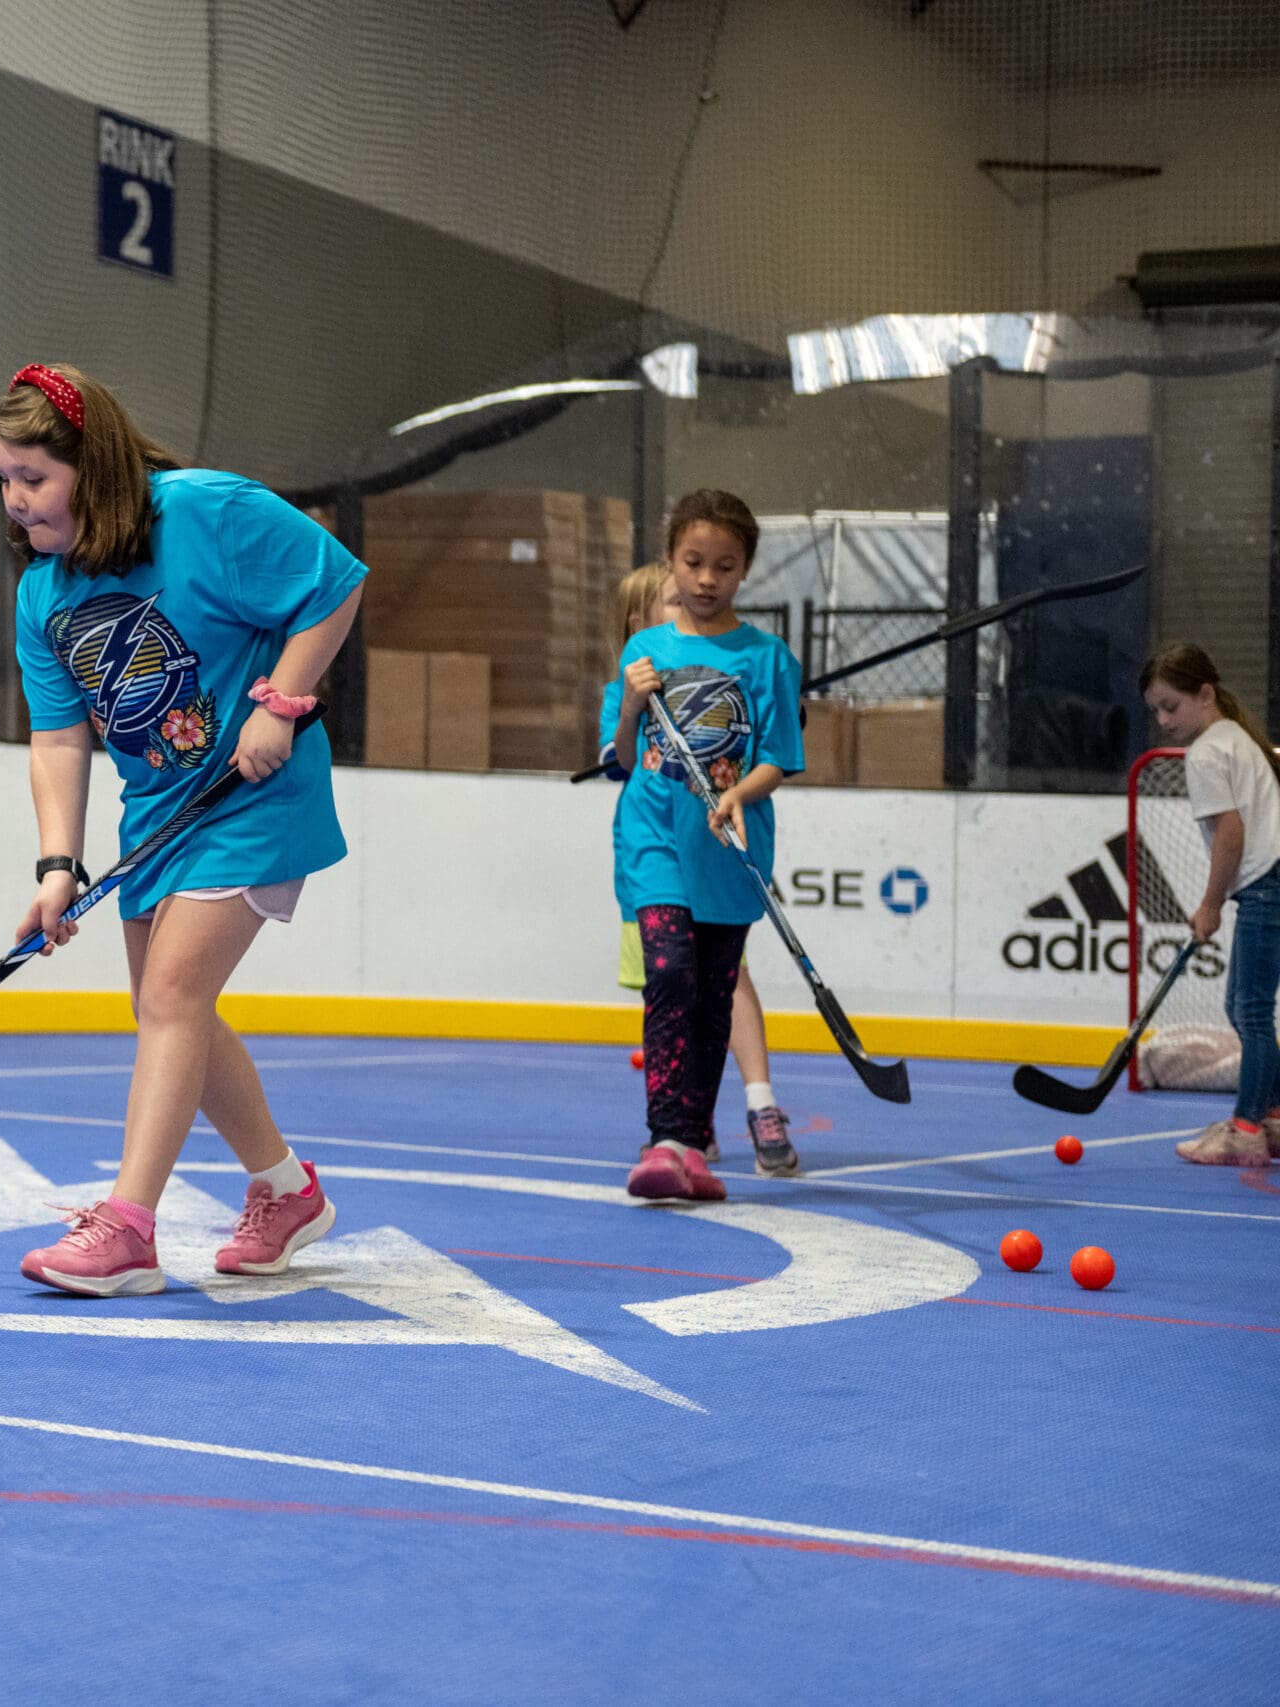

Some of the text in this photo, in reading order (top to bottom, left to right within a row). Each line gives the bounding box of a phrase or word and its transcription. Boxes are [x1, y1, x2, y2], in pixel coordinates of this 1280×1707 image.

[99, 117, 175, 187] RINK
[121, 180, 154, 265] 2
[164, 655, 196, 671] 25
[1003, 922, 1225, 978] adidas
